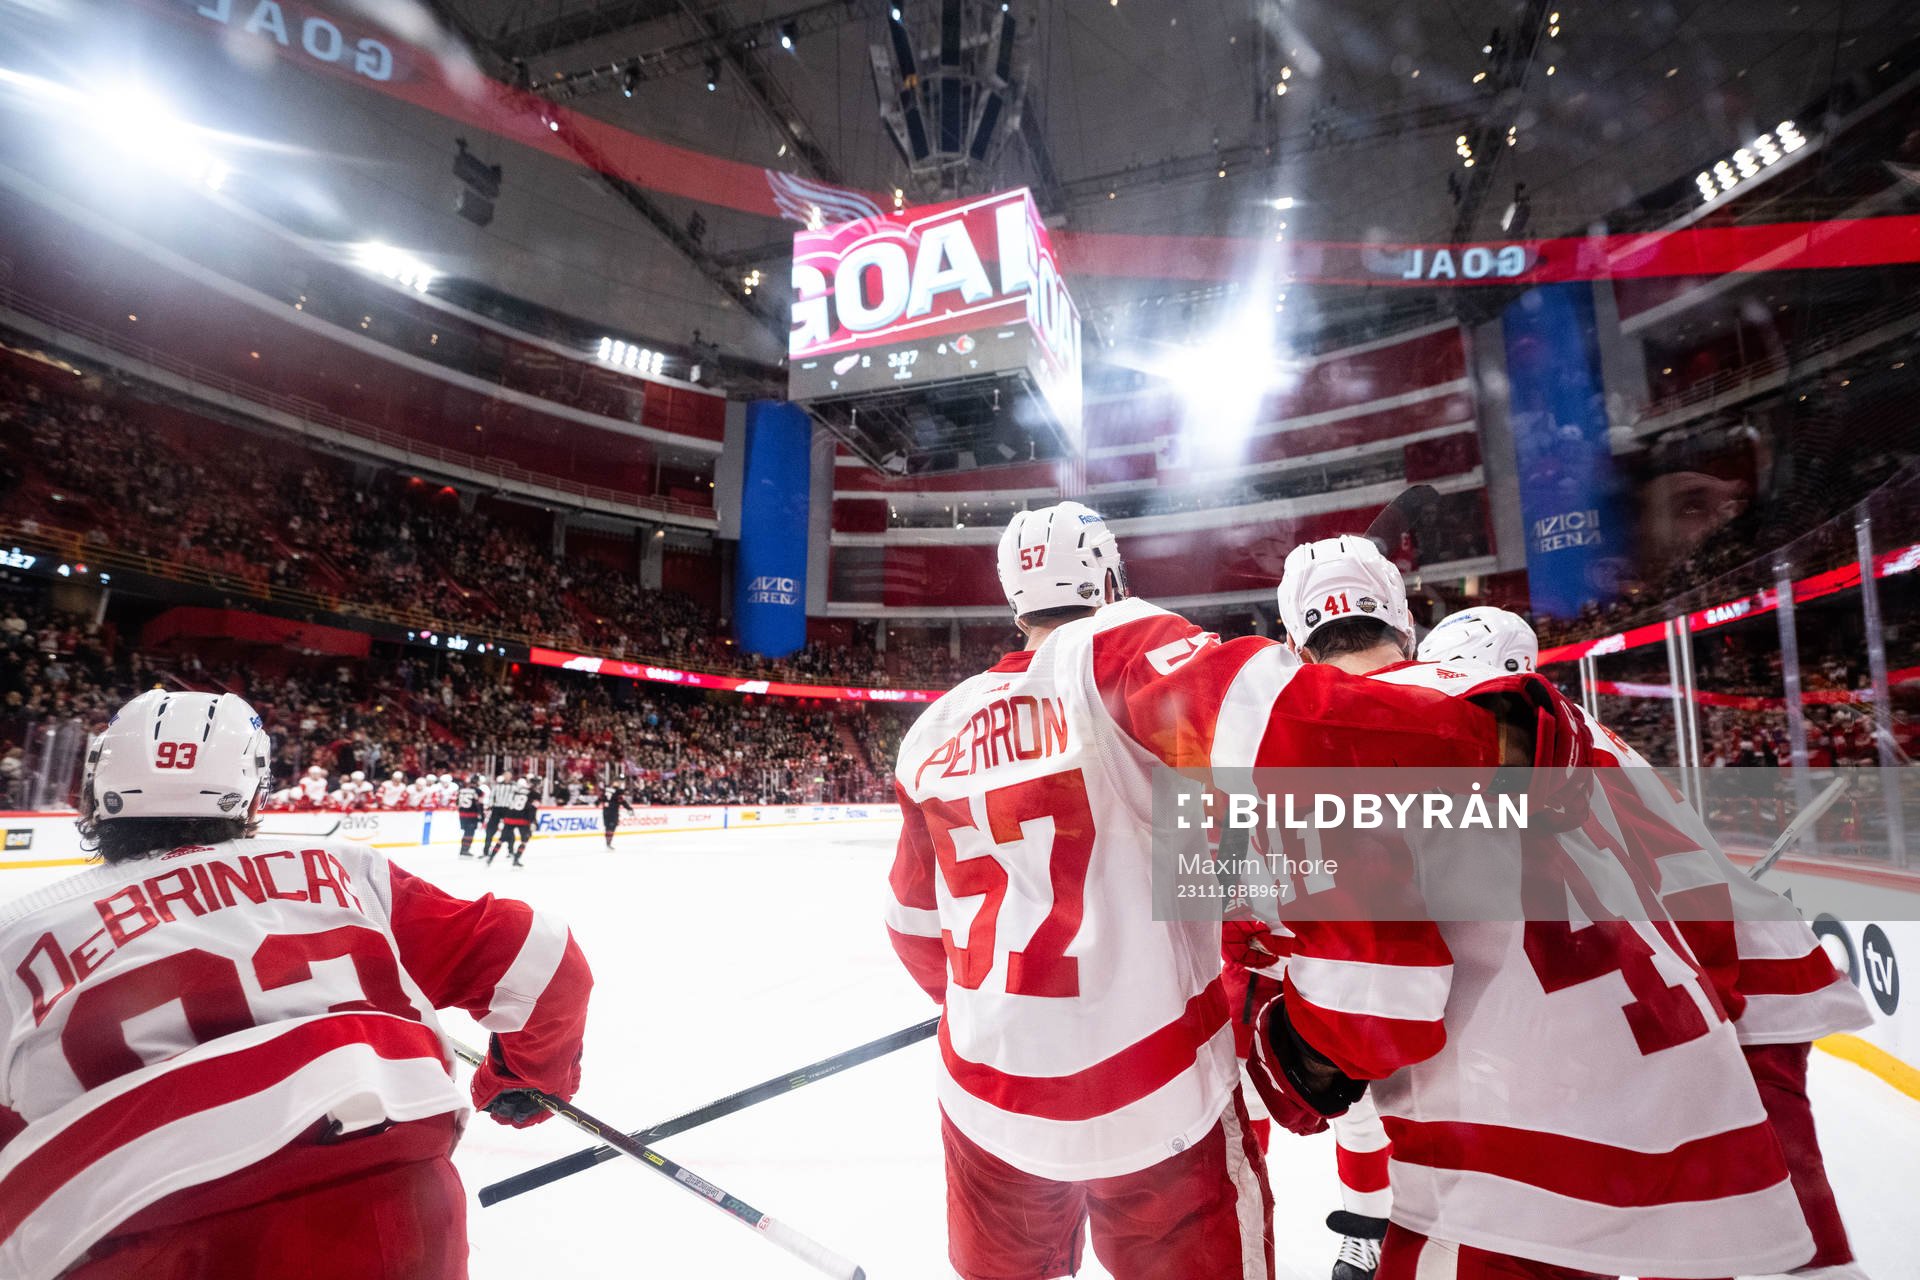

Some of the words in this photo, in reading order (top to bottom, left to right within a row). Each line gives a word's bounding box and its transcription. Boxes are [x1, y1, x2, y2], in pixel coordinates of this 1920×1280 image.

[1020, 544, 1046, 571] 57
[1324, 592, 1351, 616] 41
[155, 741, 198, 770] 93
[915, 695, 1068, 792] PERRON
[343, 815, 378, 829] aws
[538, 813, 599, 832] FASTENAL
[920, 767, 1096, 998] 57
[1866, 941, 1893, 995] tv
